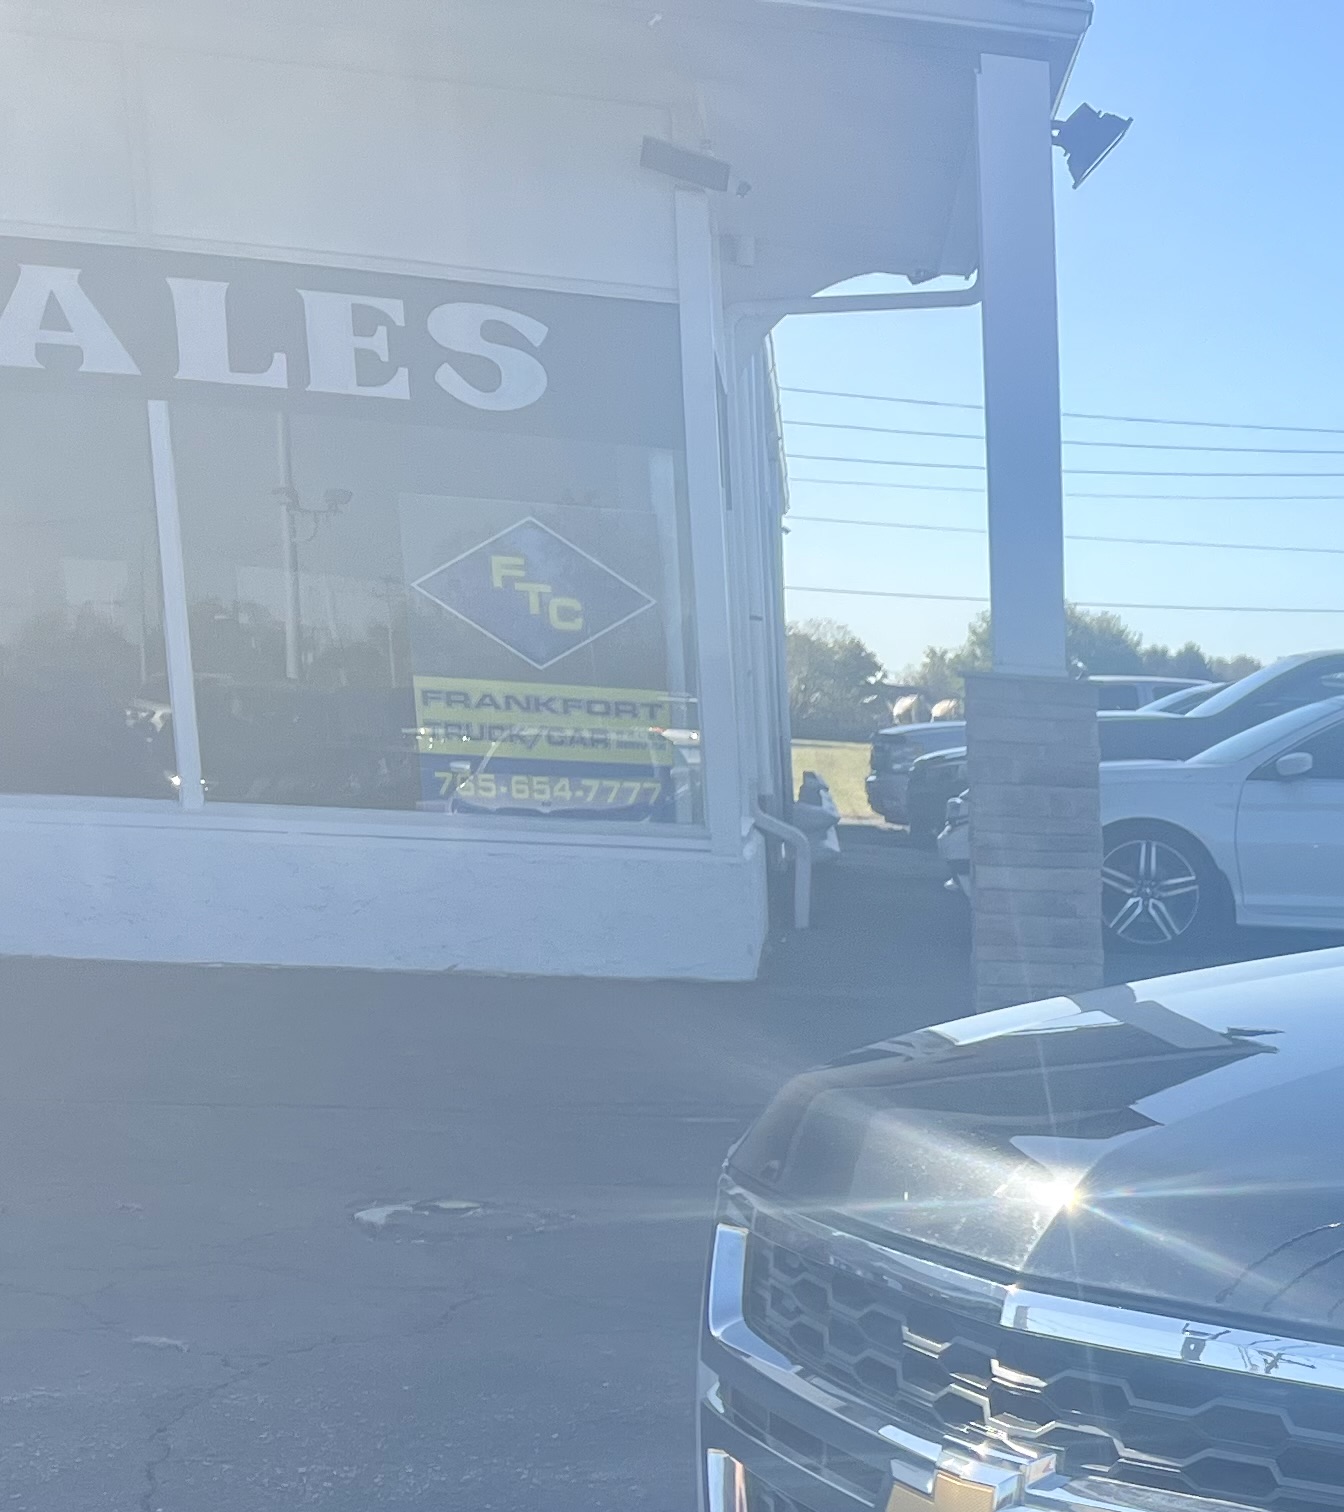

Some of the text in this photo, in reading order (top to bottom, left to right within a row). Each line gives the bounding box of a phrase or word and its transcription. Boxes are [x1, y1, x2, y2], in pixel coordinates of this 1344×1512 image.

[0, 264, 548, 411] ALES
[490, 555, 584, 631] FTC
[422, 689, 662, 720] FRANKFORT
